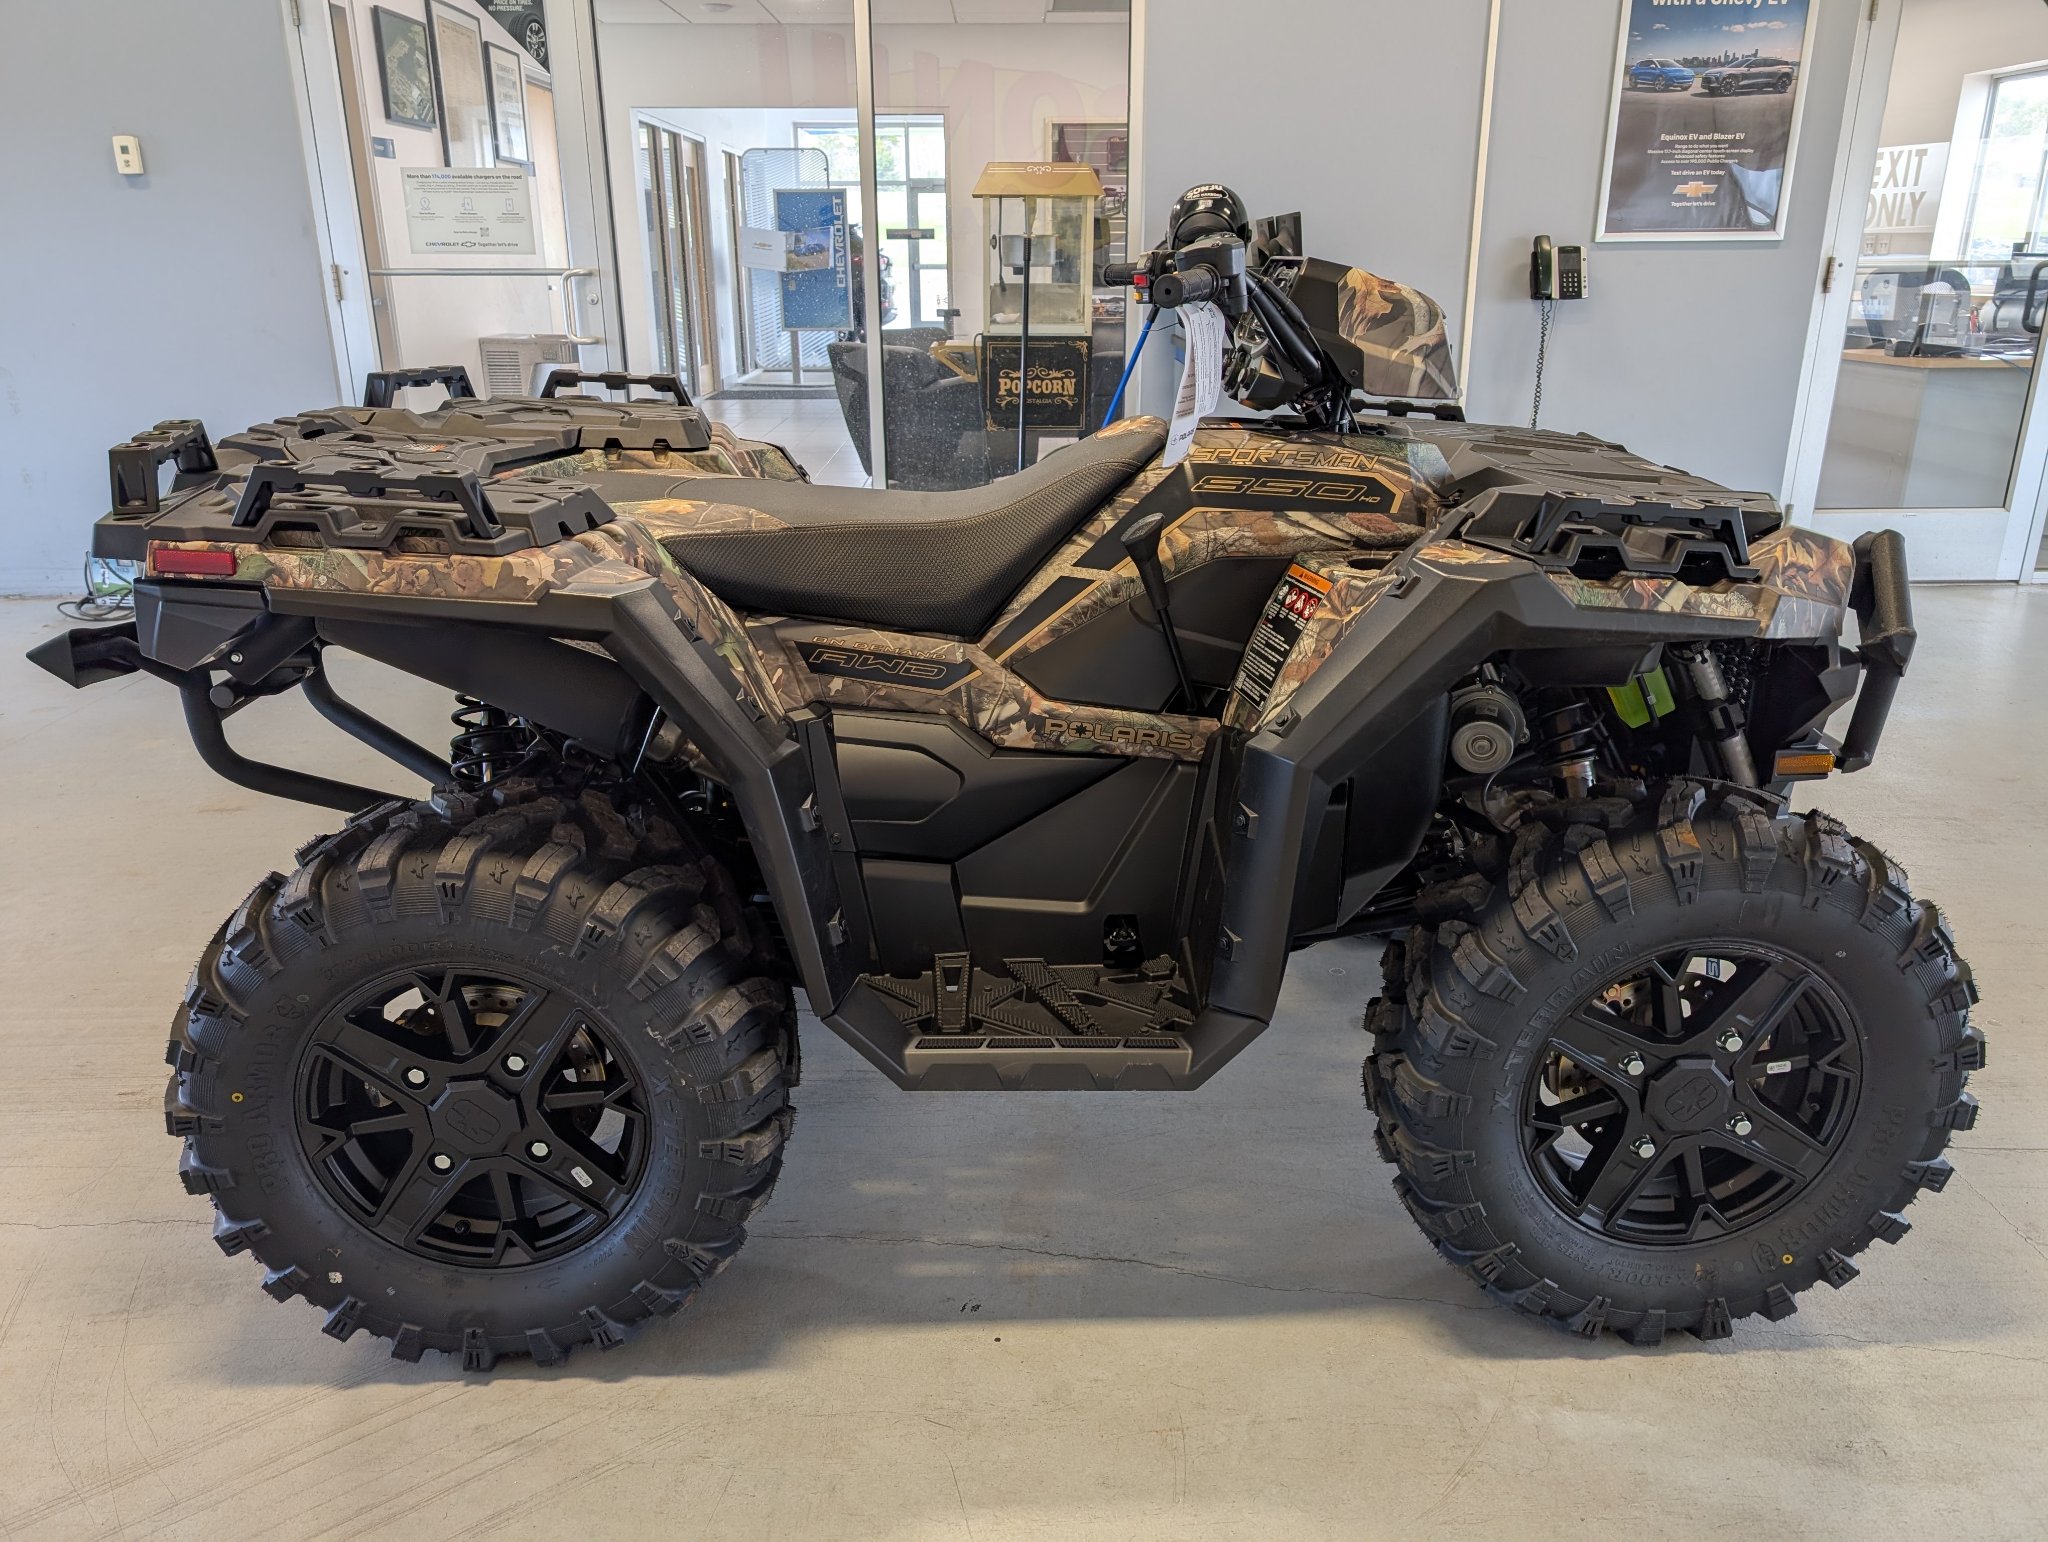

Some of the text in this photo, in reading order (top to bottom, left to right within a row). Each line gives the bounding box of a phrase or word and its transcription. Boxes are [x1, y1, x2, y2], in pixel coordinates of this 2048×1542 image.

[1661, 133, 1688, 141] Equinox
[1736, 132, 1746, 140] EV
[1871, 148, 1928, 190] EXIT
[833, 196, 847, 288] CHEVROLET
[1189, 447, 1380, 471] SPORTSMAN
[1190, 475, 1368, 501] 850
[811, 635, 948, 661] ON DEMAND
[808, 647, 949, 681] AWD
[1041, 717, 1193, 750] POLARIS
